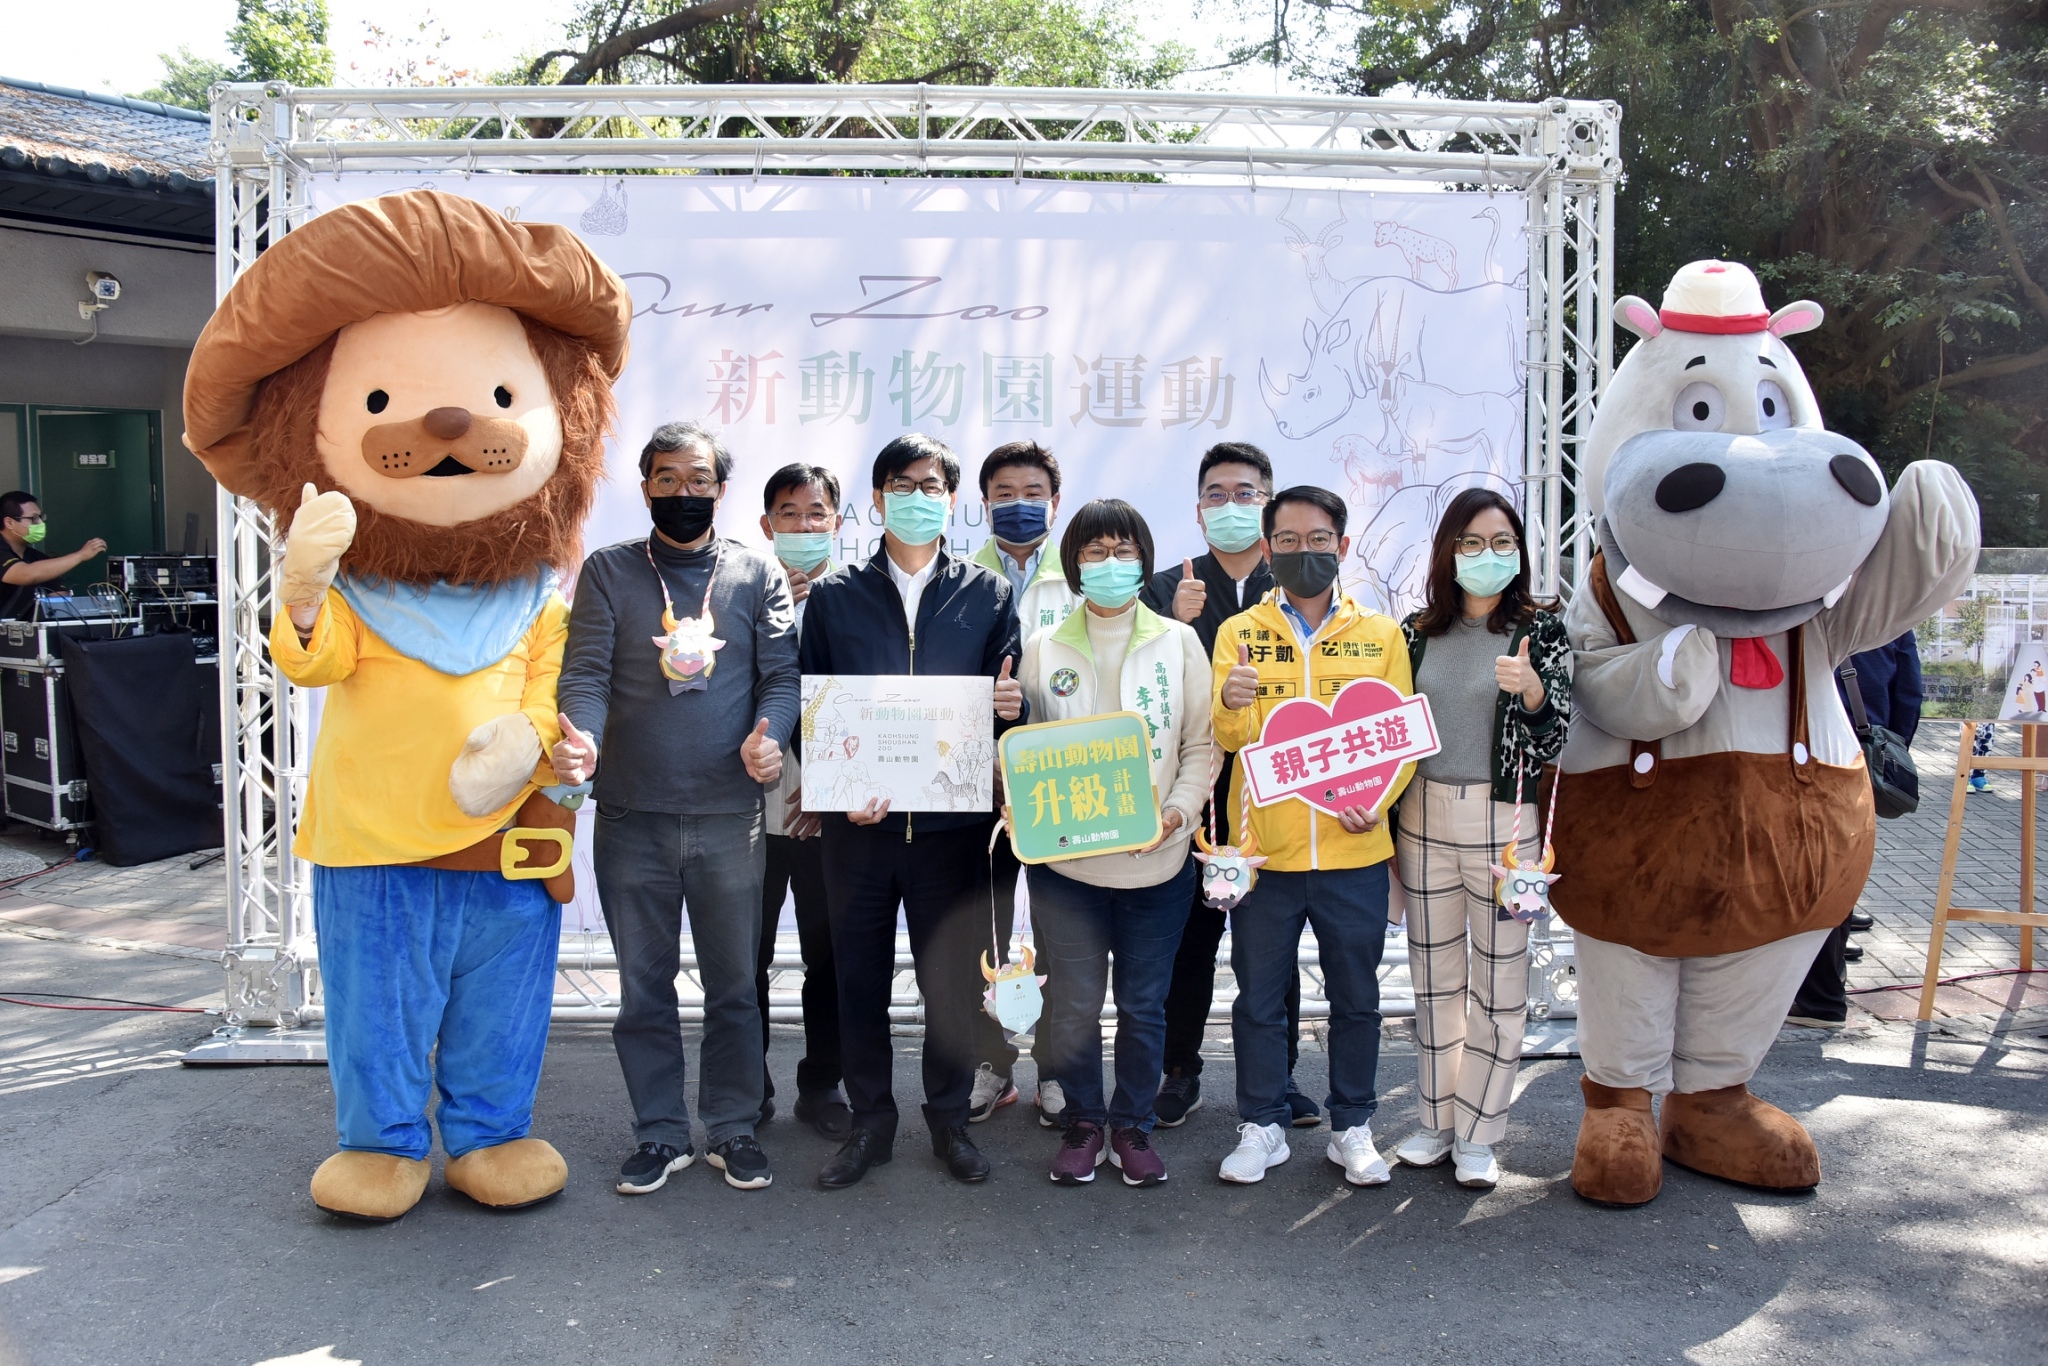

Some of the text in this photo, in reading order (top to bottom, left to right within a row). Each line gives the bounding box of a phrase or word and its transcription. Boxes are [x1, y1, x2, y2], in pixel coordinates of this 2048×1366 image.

[810, 275, 1049, 327] Zoo
[706, 348, 1236, 430] 新動物園運動
[833, 693, 920, 704] Our Zoo
[1154, 662, 1172, 730] 高雄市議員
[1256, 685, 1285, 696] 雄市
[860, 706, 955, 721] 新動物園運動
[878, 755, 919, 763] 壽山動物園
[1014, 734, 1140, 774] 壽山動物園
[1270, 715, 1412, 785] 親子共遊
[1028, 773, 1110, 827] 升級
[1112, 768, 1137, 817] 計畫
[1336, 775, 1383, 797] 壽山動物園
[1071, 829, 1120, 845] 壽山動物園
